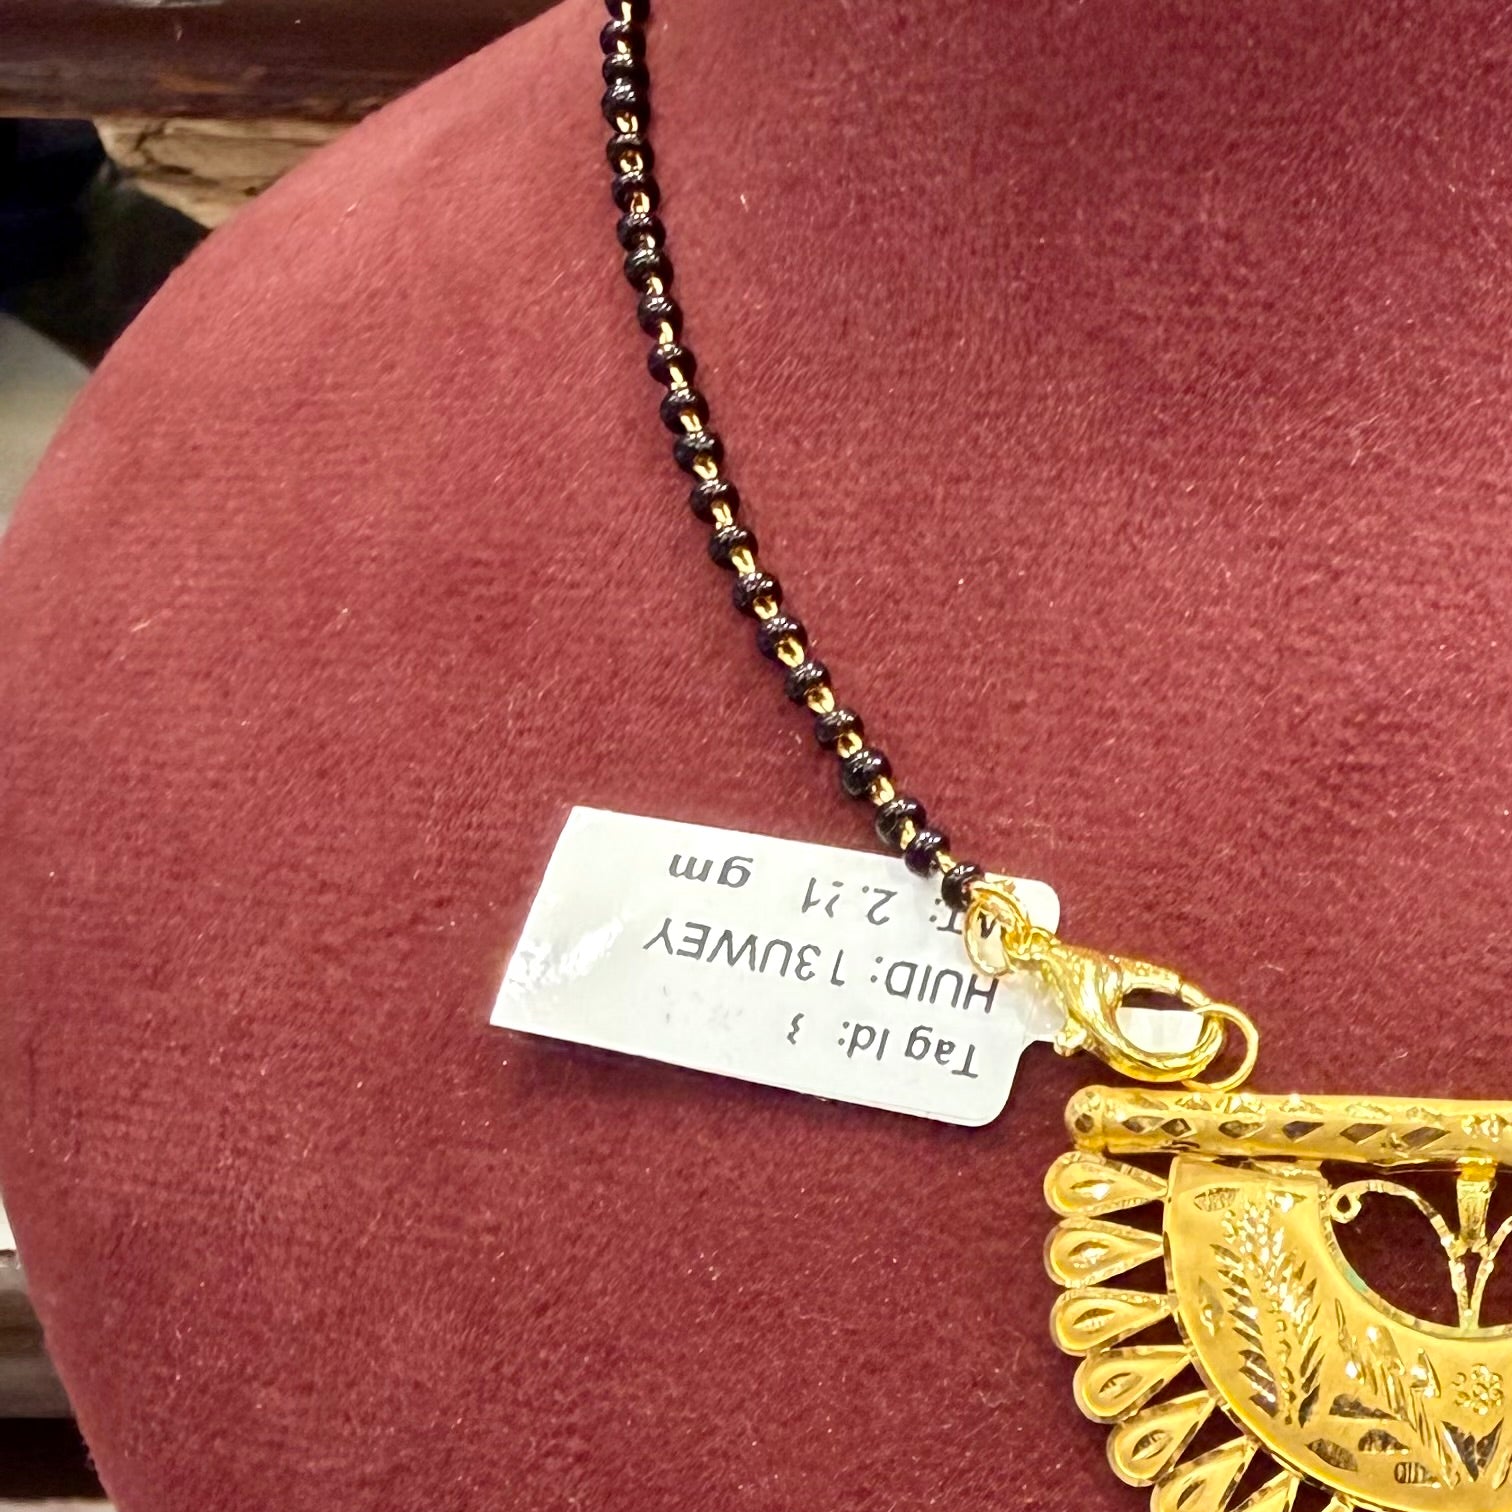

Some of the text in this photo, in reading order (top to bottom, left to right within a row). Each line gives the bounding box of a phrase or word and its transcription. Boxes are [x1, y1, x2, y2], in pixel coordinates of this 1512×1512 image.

[668, 853, 755, 889] gm
[643, 917, 999, 1013] HUID: 13UWEY
[838, 1021, 890, 1060] Id:
[905, 1025, 978, 1078] Tag
